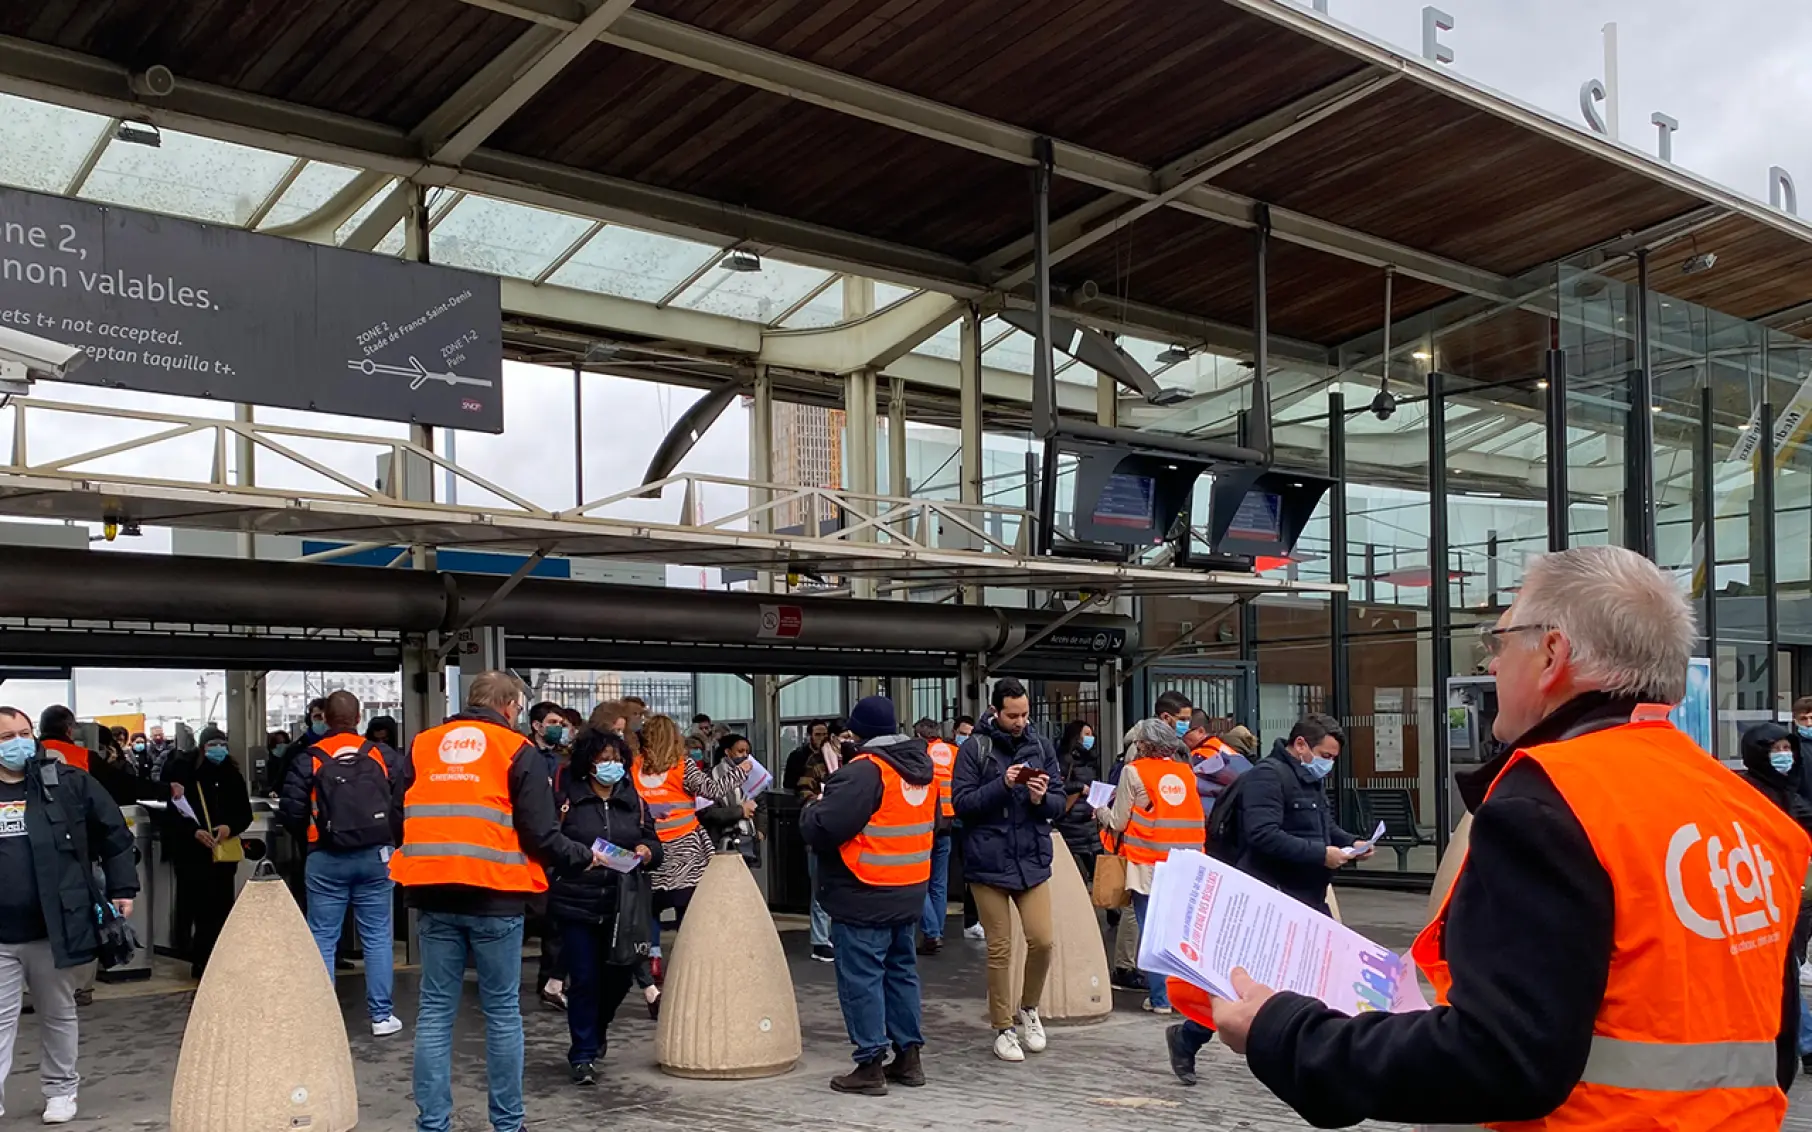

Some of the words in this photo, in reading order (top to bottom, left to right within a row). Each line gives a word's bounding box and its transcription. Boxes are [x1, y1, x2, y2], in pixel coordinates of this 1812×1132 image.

[0, 221, 46, 247] ne
[59, 224, 87, 260] 2,
[3, 258, 67, 288] non
[79, 269, 219, 311] valables.
[0, 309, 31, 325] ets
[37, 312, 56, 328] t+
[62, 318, 95, 334] not
[98, 323, 182, 346] accepted.
[356, 325, 382, 345] ZONE
[381, 321, 390, 331] 2
[363, 339, 389, 356] Stade
[389, 331, 400, 342] de
[399, 316, 427, 336] France
[426, 289, 472, 320] Saint-Denis
[440, 339, 464, 358] ZONE
[462, 329, 479, 344] 1-2
[445, 353, 466, 367] Paris
[143, 351, 209, 371] taquilla
[214, 360, 236, 375] t+.
